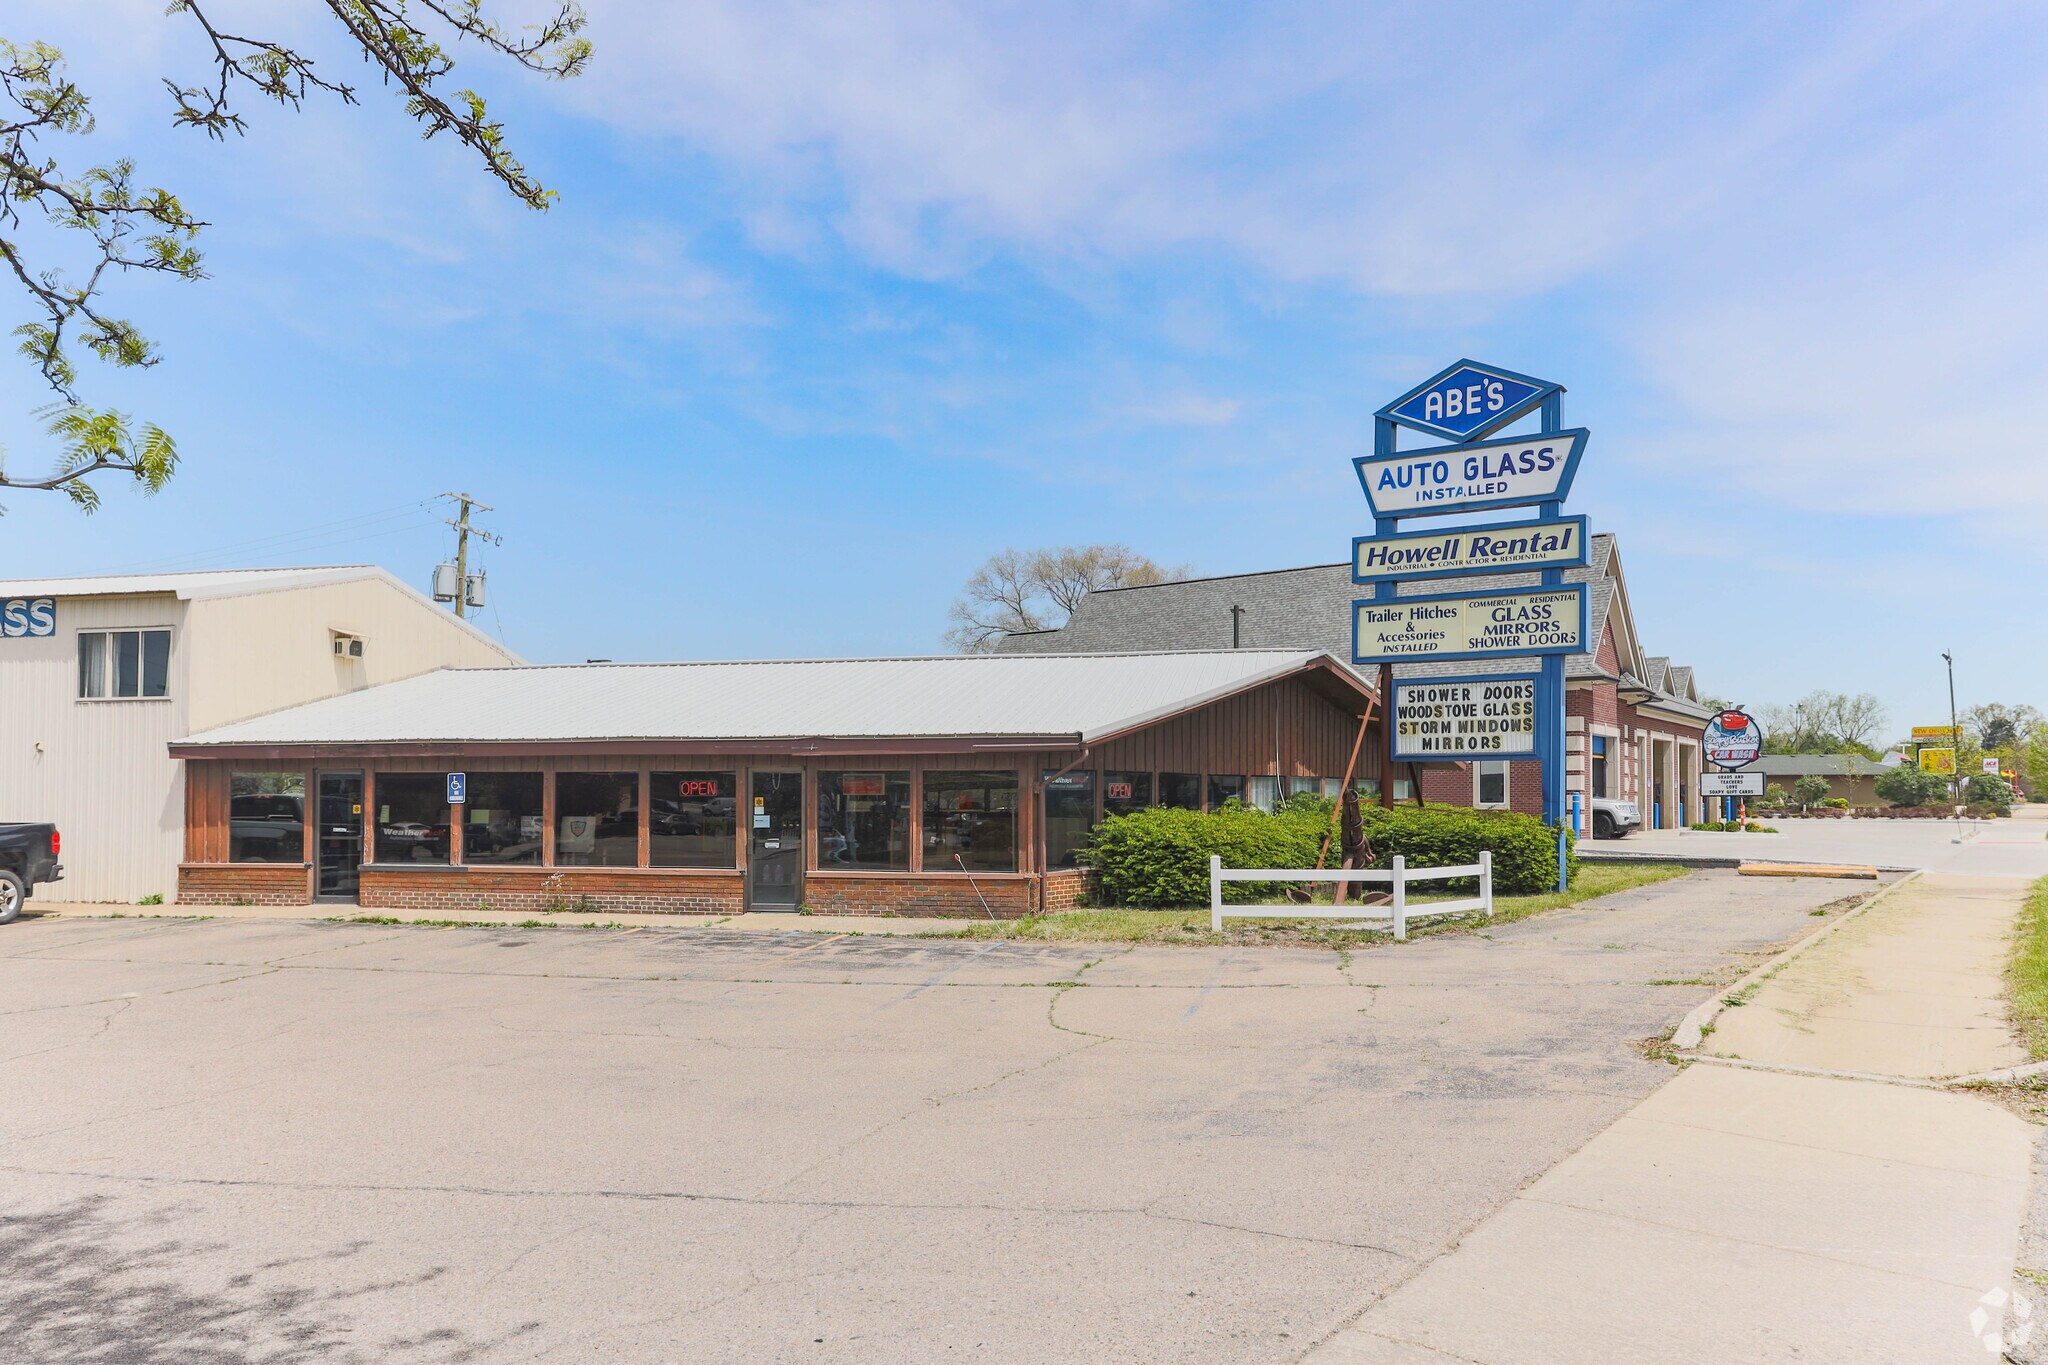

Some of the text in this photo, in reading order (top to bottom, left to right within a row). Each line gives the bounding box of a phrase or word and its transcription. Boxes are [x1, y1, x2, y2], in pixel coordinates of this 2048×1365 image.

[1425, 378, 1504, 421] ABE'S
[1377, 448, 1555, 491] AUTO GLASS
[1416, 481, 1508, 502] INSTALLED
[1366, 527, 1573, 567] Howell Rental
[1387, 552, 1547, 572] INDUSTRIAL CONTRACTOR RESIDENTIAL
[1469, 593, 1576, 609] COMMERCIAL RESIDENTIAL
[0, 599, 54, 637] SS
[1366, 605, 1457, 623] Trailer Hitches
[1492, 604, 1552, 622] GLASS
[1406, 621, 1415, 632] &
[1483, 620, 1560, 636] MIRRORS
[1377, 629, 1445, 643] Accessories
[1469, 631, 1576, 649] SHOWER DOORS
[1383, 642, 1438, 654] INSTALLED
[1408, 684, 1533, 703] SHOWER DOORS
[1398, 701, 1533, 719] WOODSTOVE GLASS
[1399, 717, 1533, 735] STORM WINDOWS
[1422, 736, 1501, 750] MIRRORS
[1715, 750, 1754, 759] CAR WASH
[681, 781, 717, 796] OPEN
[1108, 784, 1131, 797] OPEN
